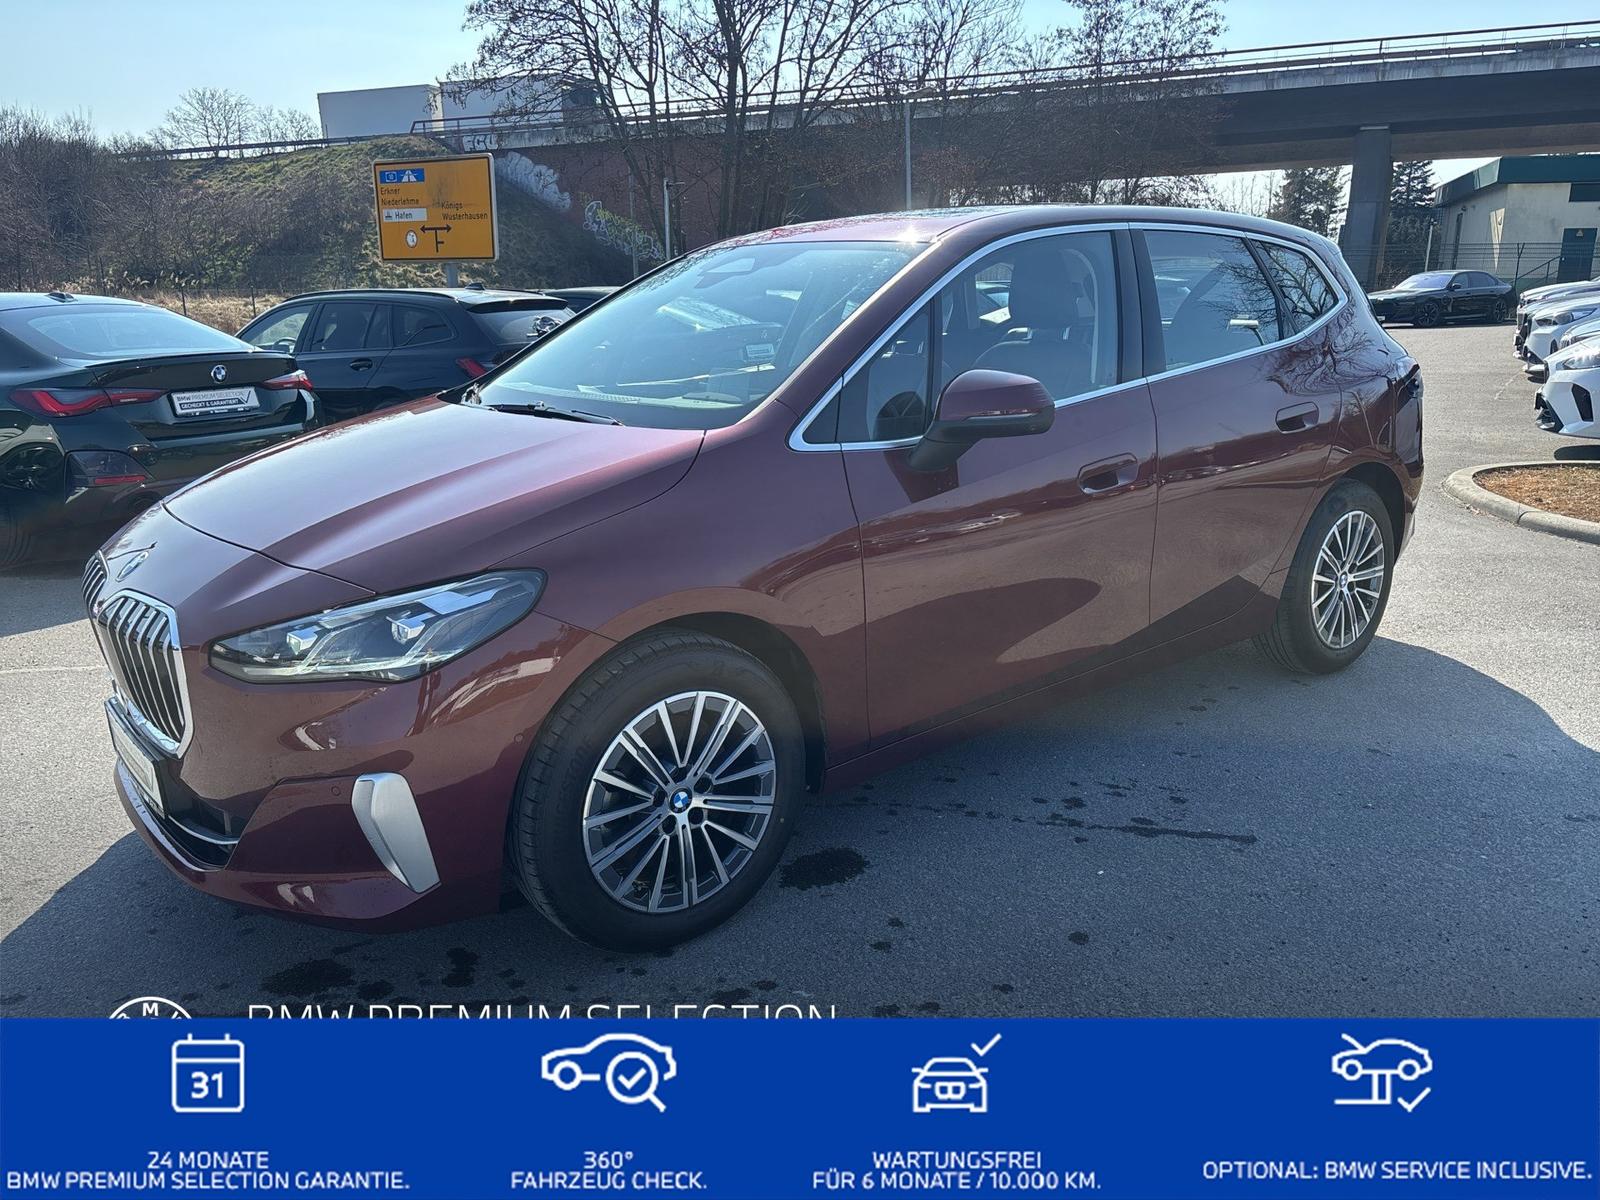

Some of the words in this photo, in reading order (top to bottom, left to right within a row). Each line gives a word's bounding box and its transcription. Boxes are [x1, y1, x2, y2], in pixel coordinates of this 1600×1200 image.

[380, 187, 400, 195] Erkner
[381, 198, 420, 206] Niederlehme
[441, 201, 463, 211] Königs
[442, 212, 488, 221] Wusterhausen
